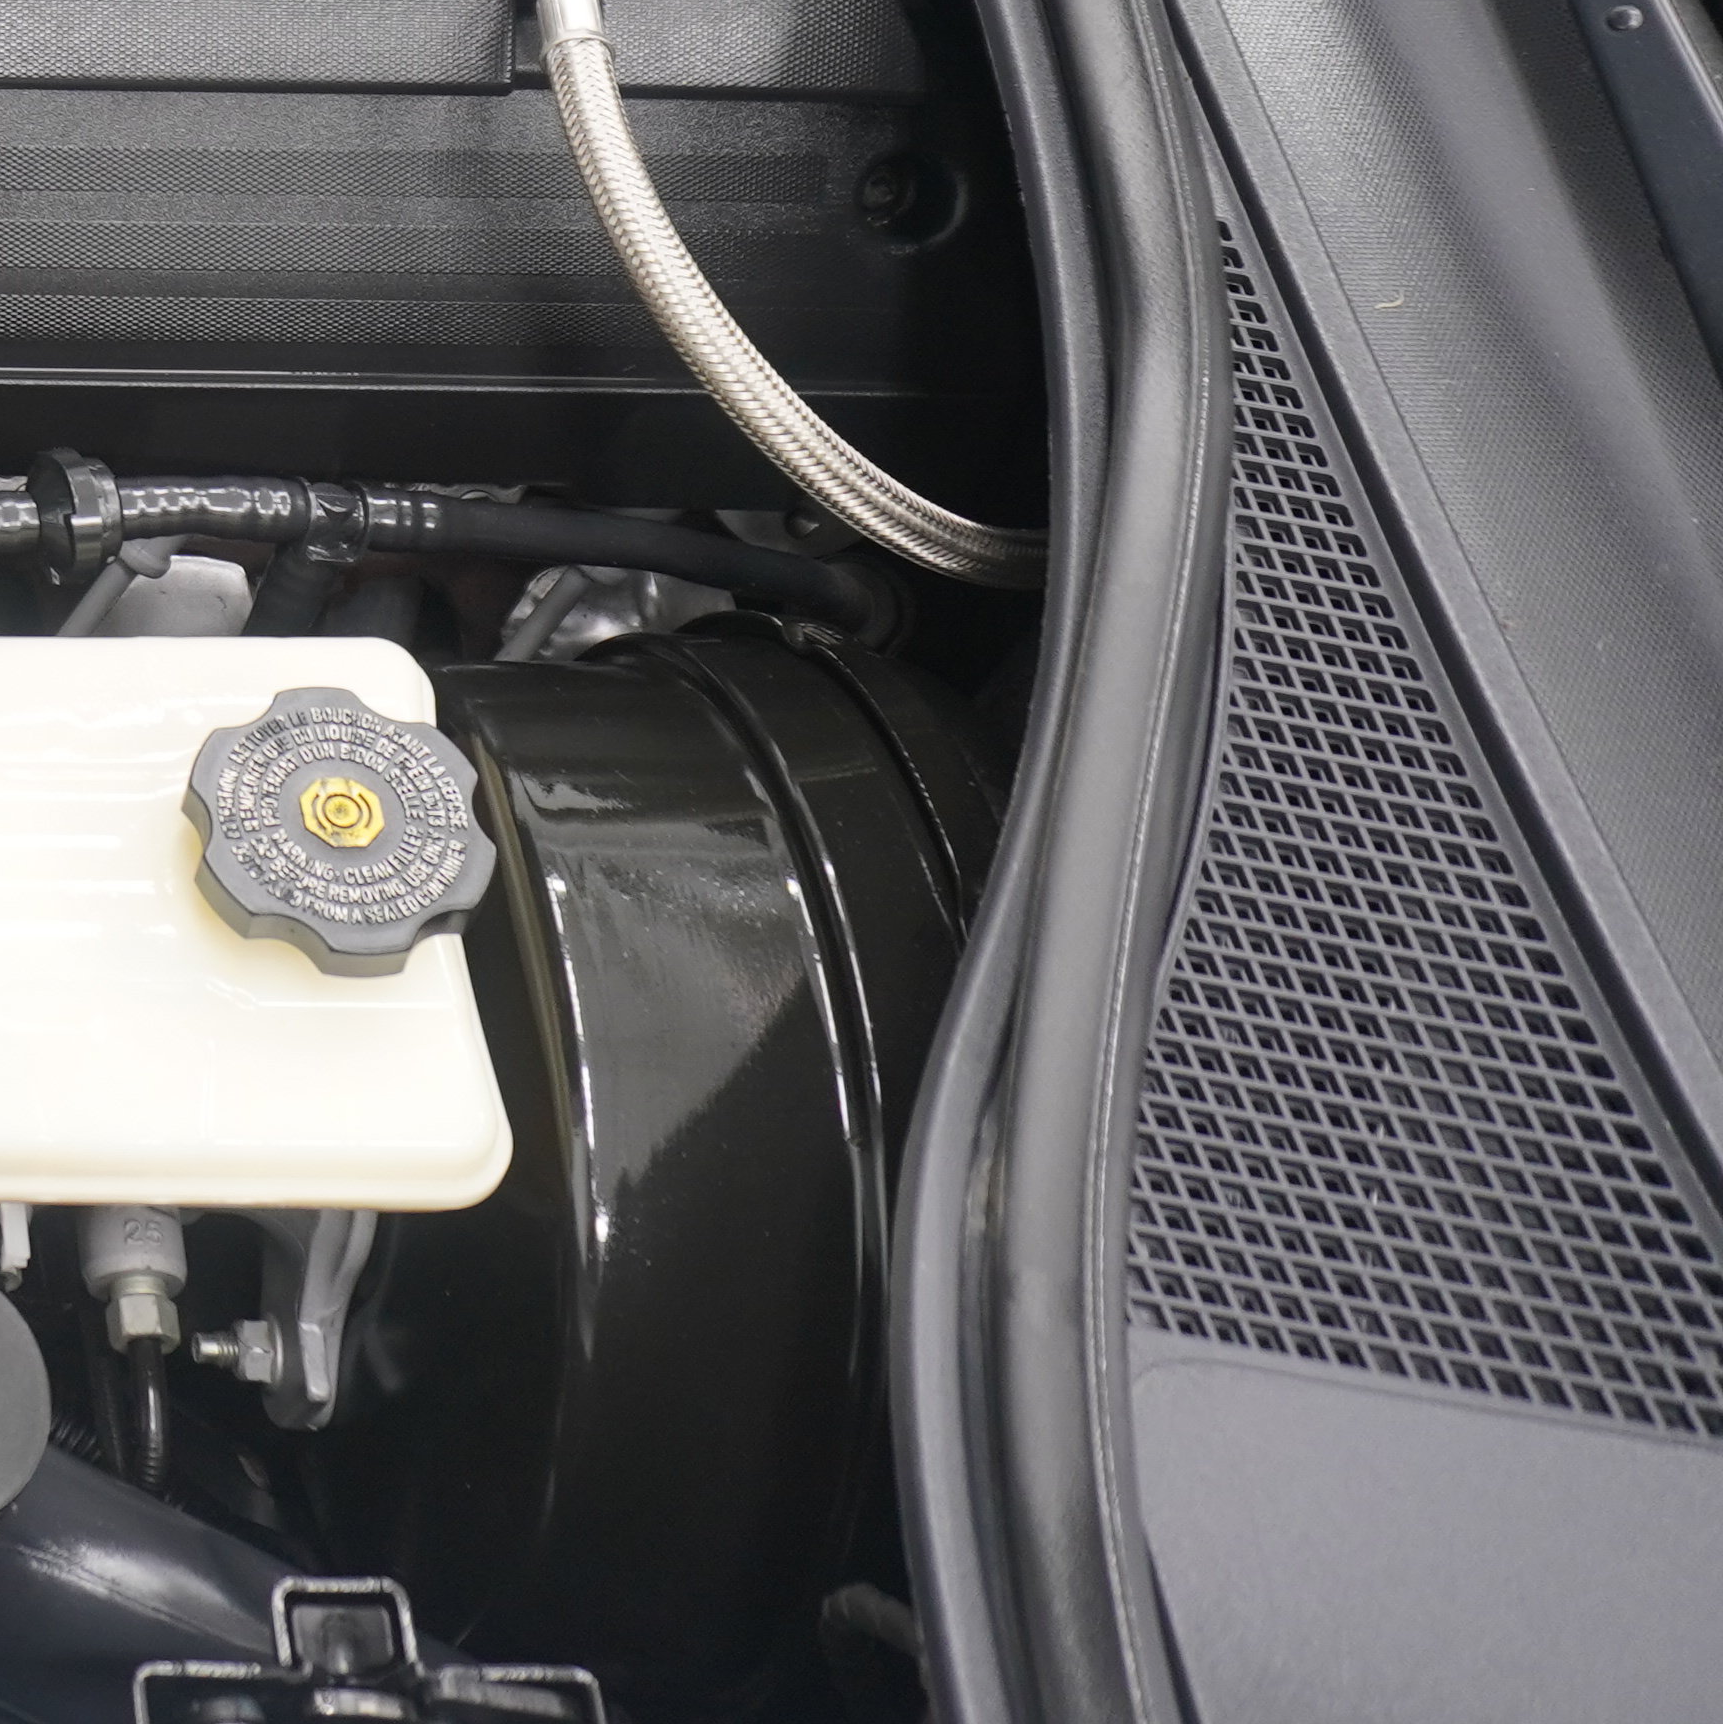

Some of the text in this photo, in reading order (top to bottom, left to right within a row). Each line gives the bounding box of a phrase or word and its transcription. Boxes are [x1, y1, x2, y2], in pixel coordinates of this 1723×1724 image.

[290, 726, 315, 747] DU
[374, 736, 399, 761] DE
[422, 756, 447, 779] LA
[342, 859, 395, 885] CLEAN
[401, 858, 435, 889] USE
[350, 907, 364, 925] A
